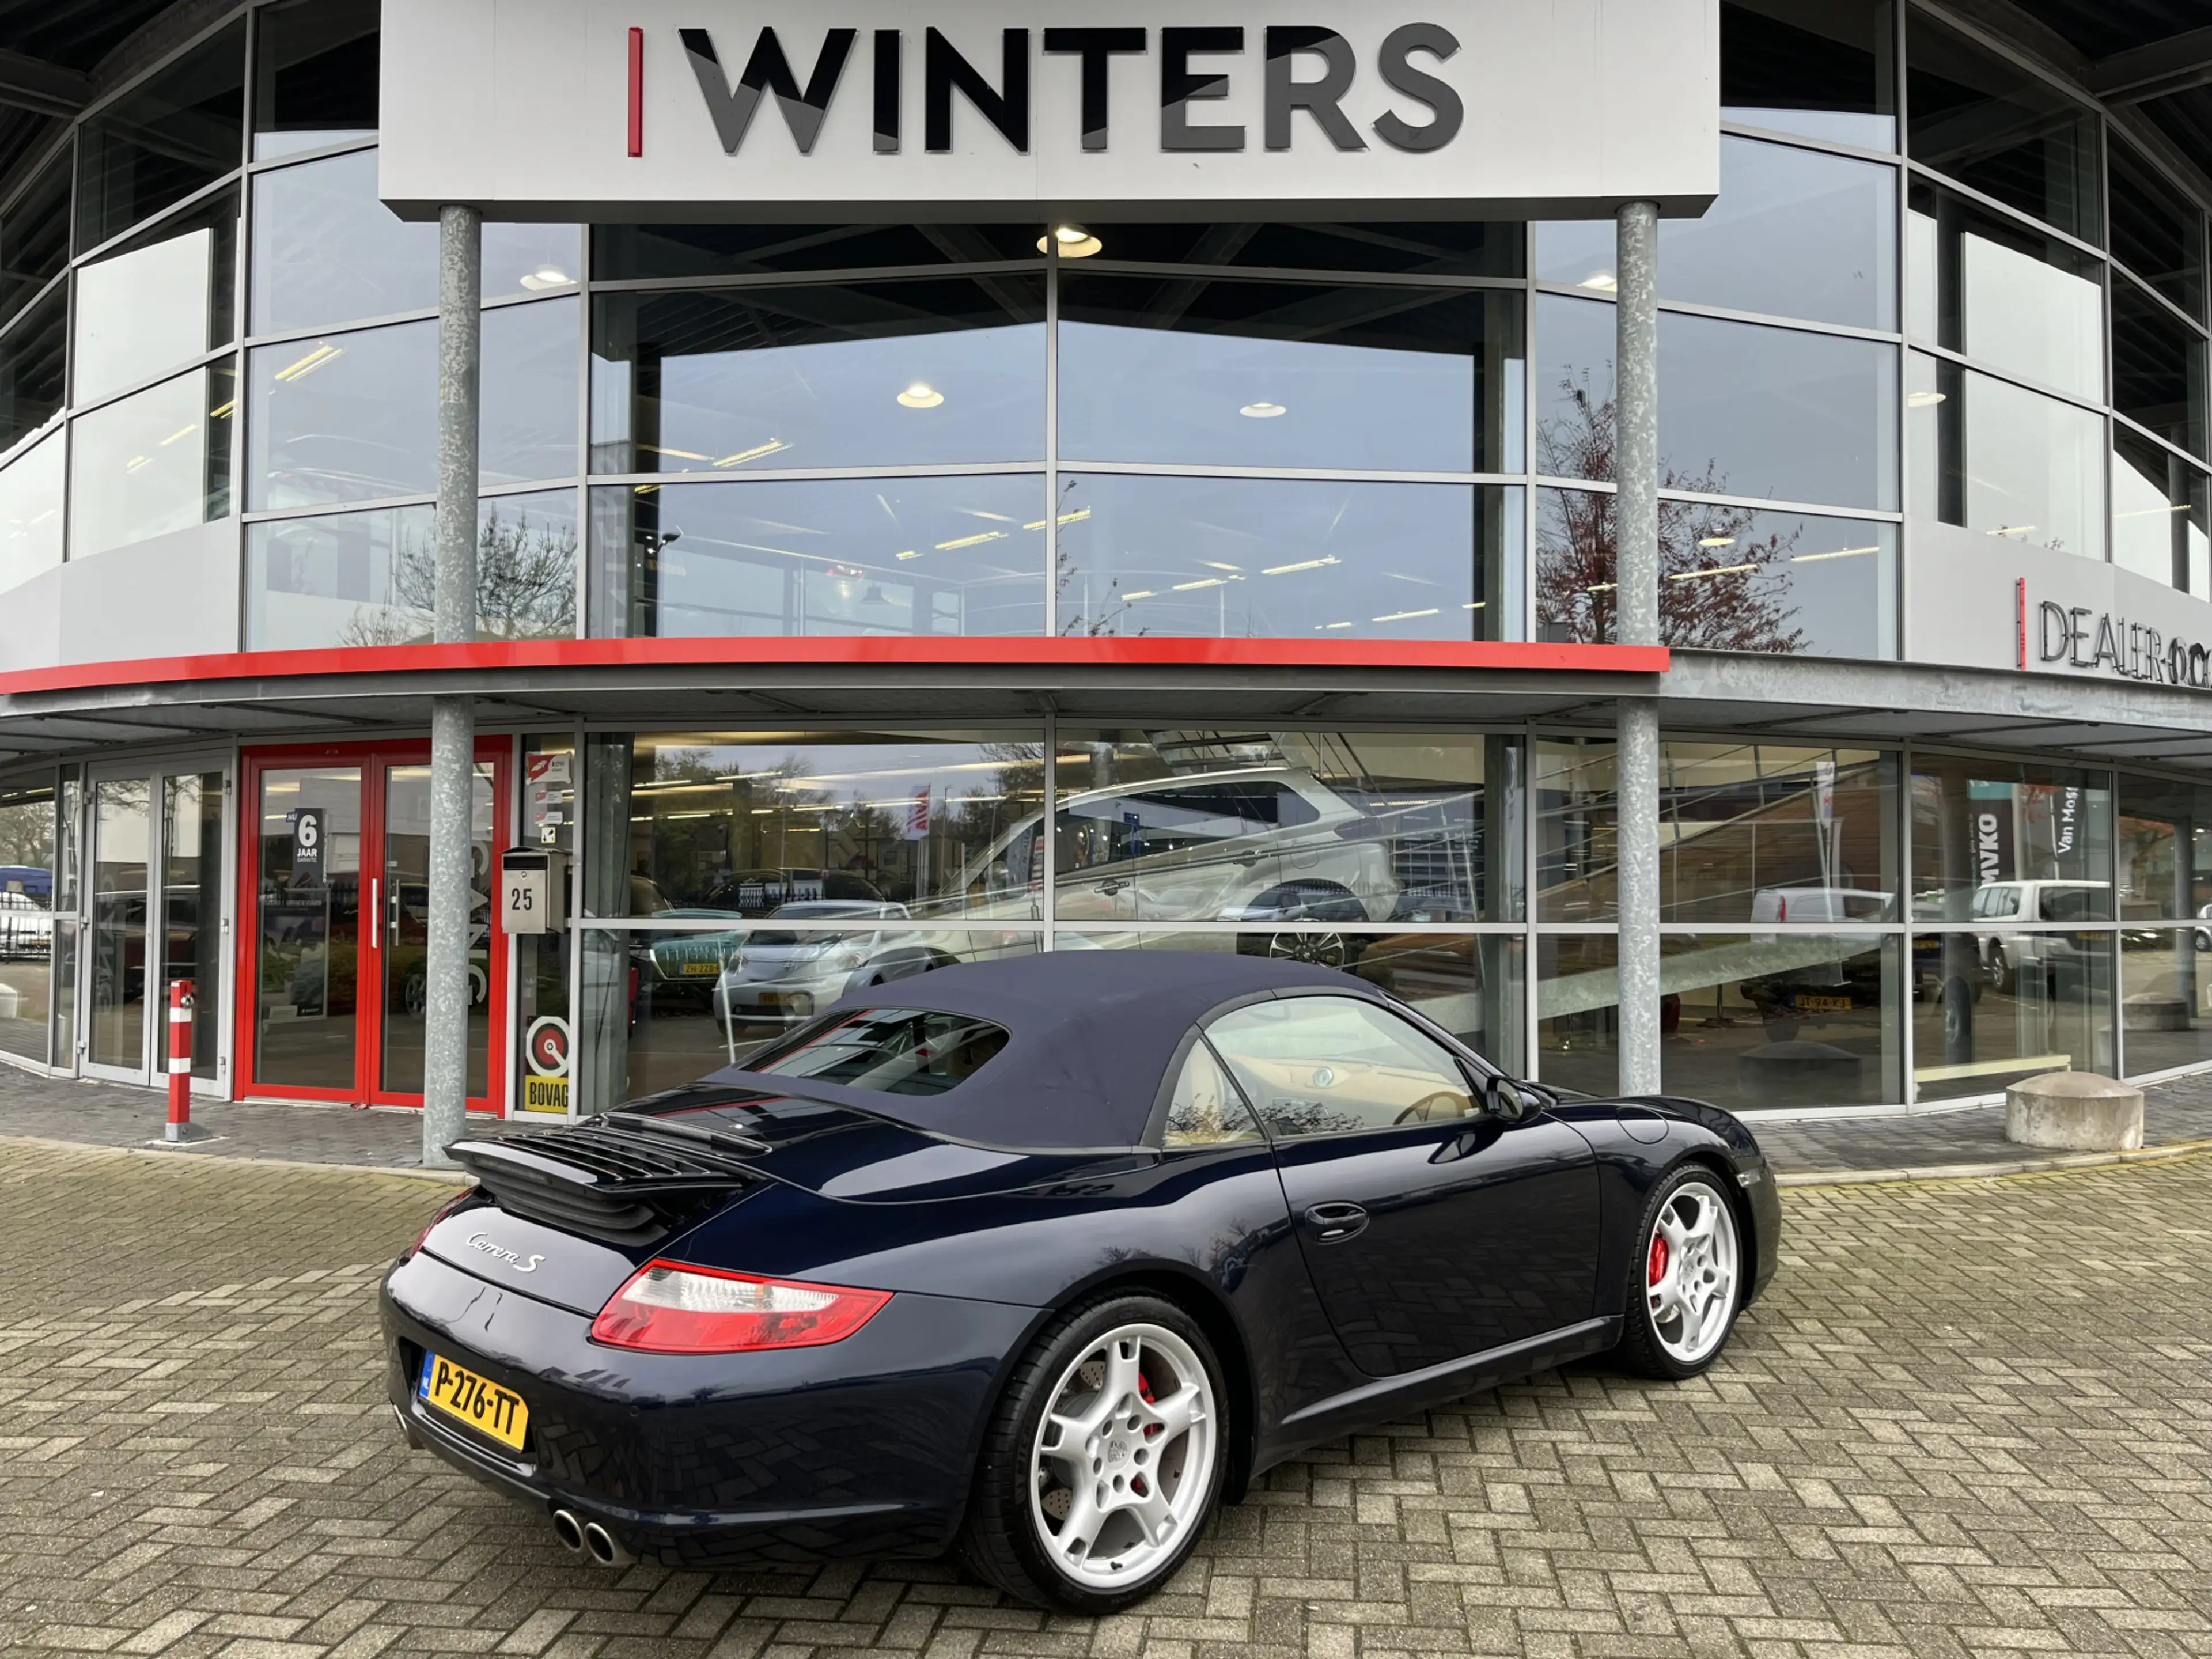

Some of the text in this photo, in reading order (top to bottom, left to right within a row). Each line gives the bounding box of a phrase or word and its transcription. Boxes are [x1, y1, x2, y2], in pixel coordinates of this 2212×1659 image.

[677, 22, 1464, 154] WINTERS
[298, 814, 317, 847] 6
[2056, 826, 2074, 854] Van
[297, 847, 317, 857] JAAR
[511, 888, 532, 911] 25
[1800, 997, 1846, 1008] JT-94-KJ
[529, 1081, 569, 1108] BOVAG
[466, 1232, 546, 1272] Carrera S
[435, 1361, 520, 1435] P-276-TT
